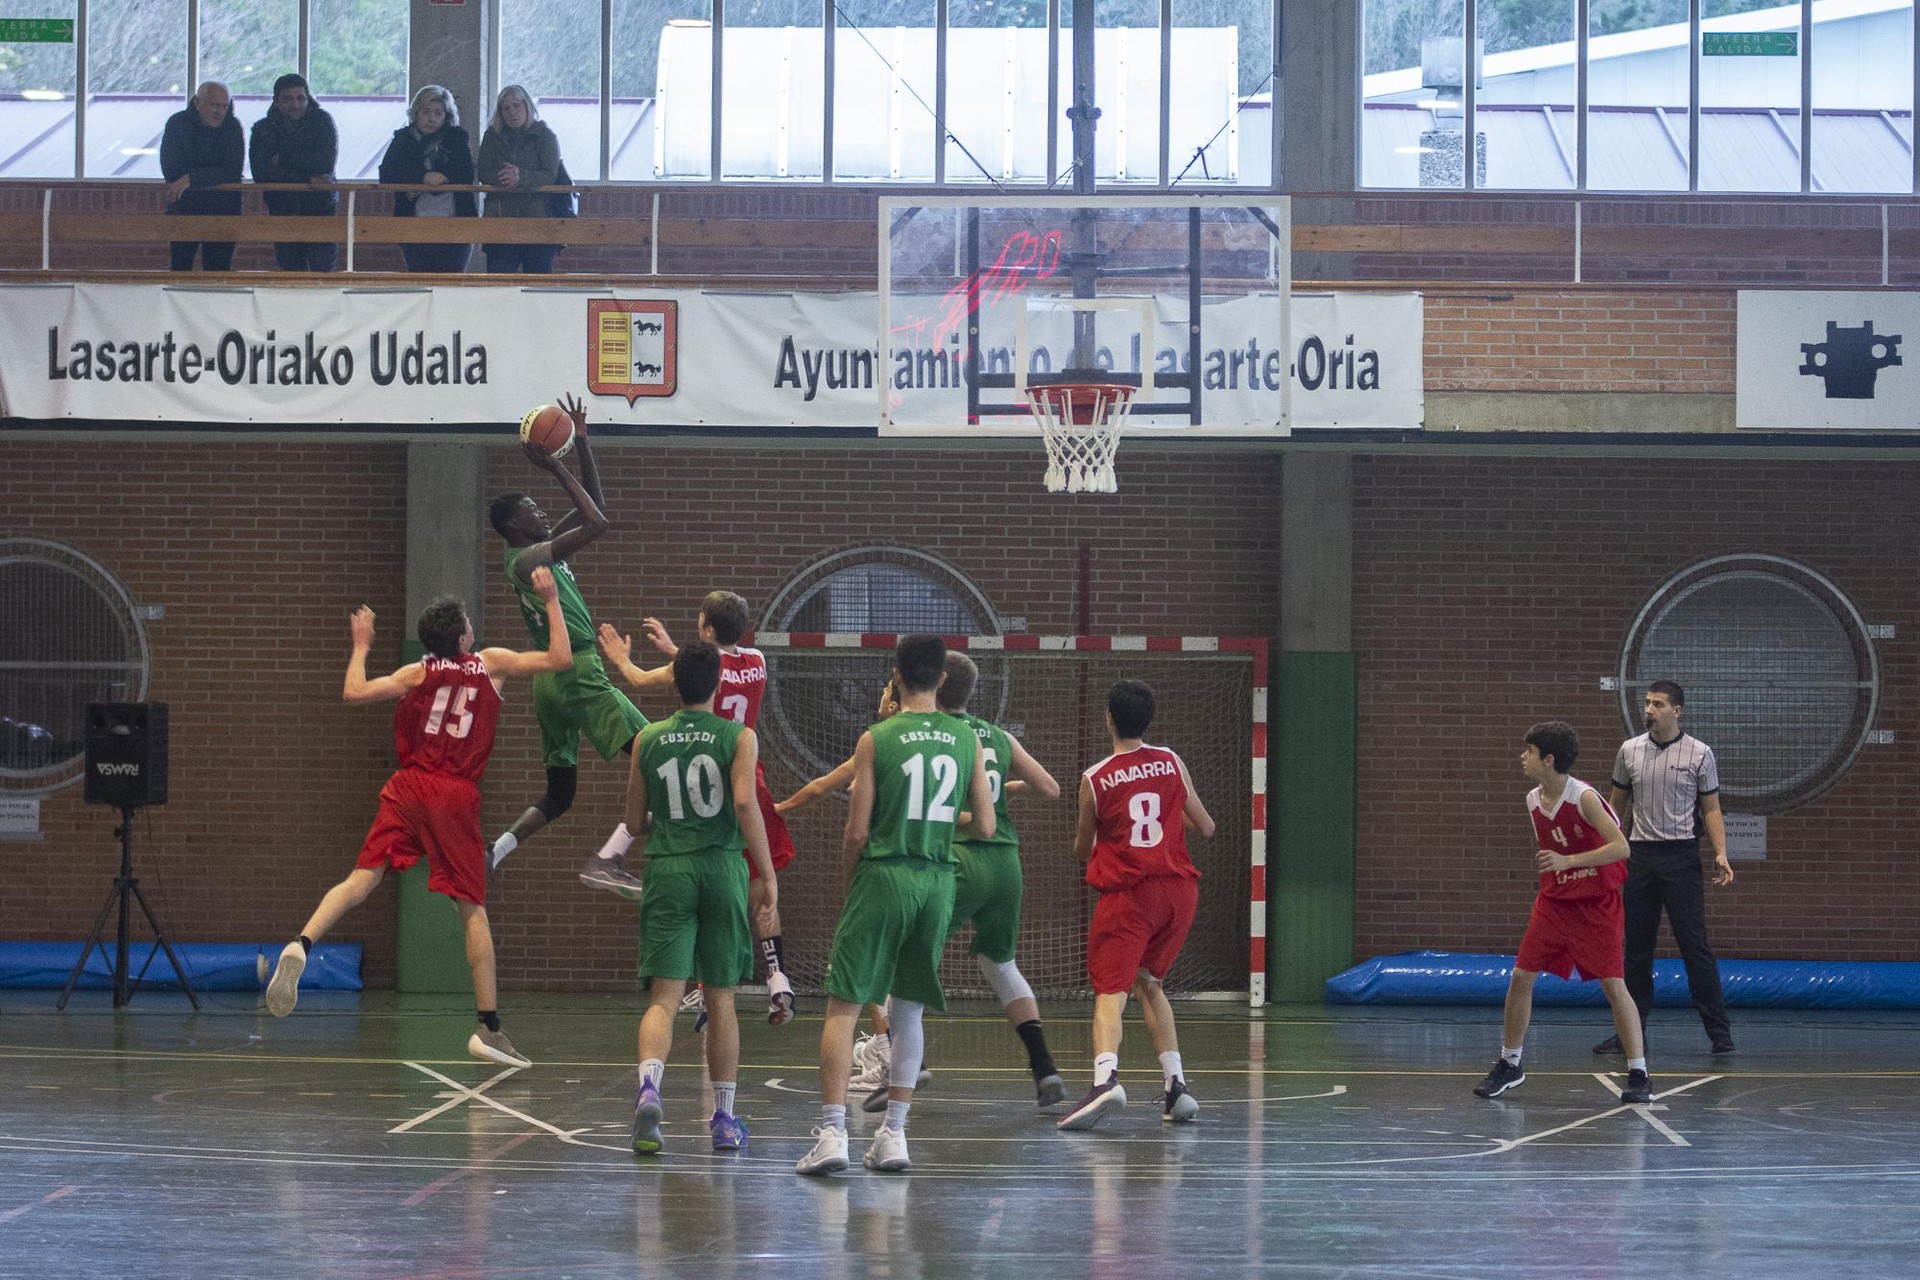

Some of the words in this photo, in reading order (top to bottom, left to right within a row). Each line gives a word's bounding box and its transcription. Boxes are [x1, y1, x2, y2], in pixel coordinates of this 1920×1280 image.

[1706, 33, 1771, 43] IRTEERA
[1706, 45, 1763, 54] SALIDA
[48, 326, 354, 386] Lasarte-Oriako
[369, 330, 488, 386] Udala
[774, 334, 1051, 402] Ayunamino
[424, 685, 479, 739] 15
[660, 731, 716, 745] EUSKADI
[900, 730, 956, 745] EUSKADI
[656, 753, 724, 820] 10
[901, 752, 958, 823] 12
[1100, 760, 1177, 791] NAVARRA
[1129, 791, 1164, 848] 8
[1551, 826, 1569, 847] 4
